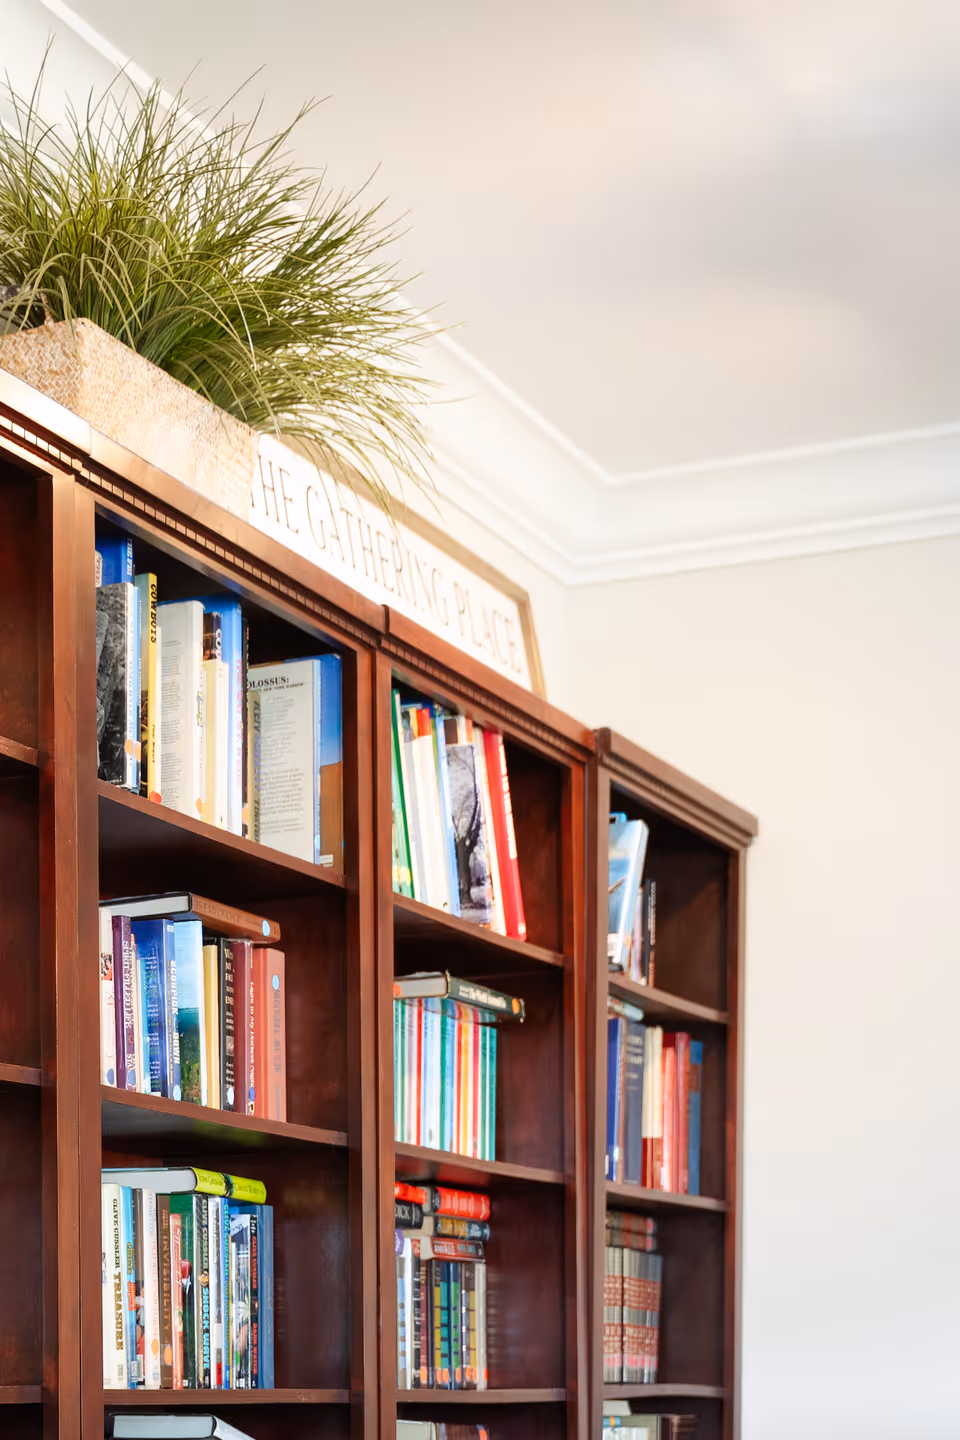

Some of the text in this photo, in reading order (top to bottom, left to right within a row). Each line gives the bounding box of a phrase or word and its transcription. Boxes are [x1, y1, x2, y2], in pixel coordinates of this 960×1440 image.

[253, 454, 299, 535] HE
[453, 579, 523, 675] PLACE
[150, 583, 158, 644] COWBOYS
[170, 960, 181, 1065] SCORPION DOWN
[112, 1198, 124, 1351] CLIVE CUSSLER TREASURE
[202, 1286, 210, 1331] SHOCK
[202, 1332, 210, 1370] WAVE
